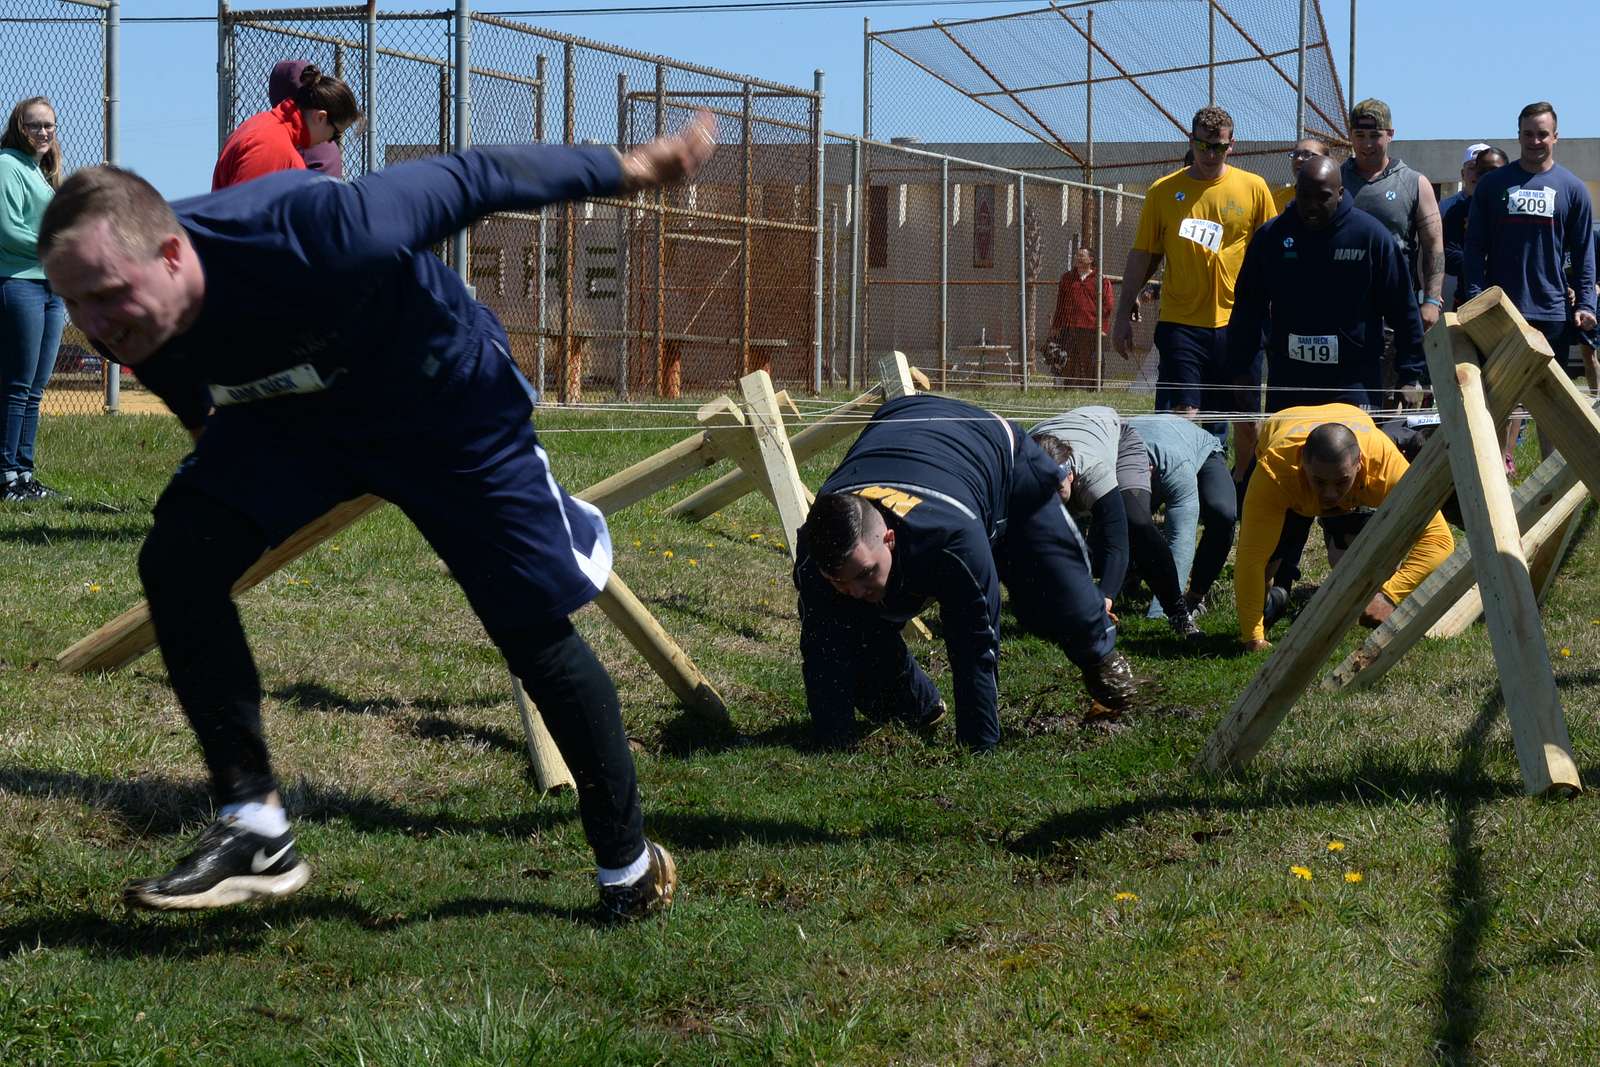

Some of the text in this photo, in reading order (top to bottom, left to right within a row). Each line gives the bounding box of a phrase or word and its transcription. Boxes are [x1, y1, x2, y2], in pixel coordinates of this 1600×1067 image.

[1517, 197, 1546, 213] 209
[1190, 224, 1215, 247] 111
[1334, 248, 1367, 261] NAVY
[1297, 344, 1330, 361] 119
